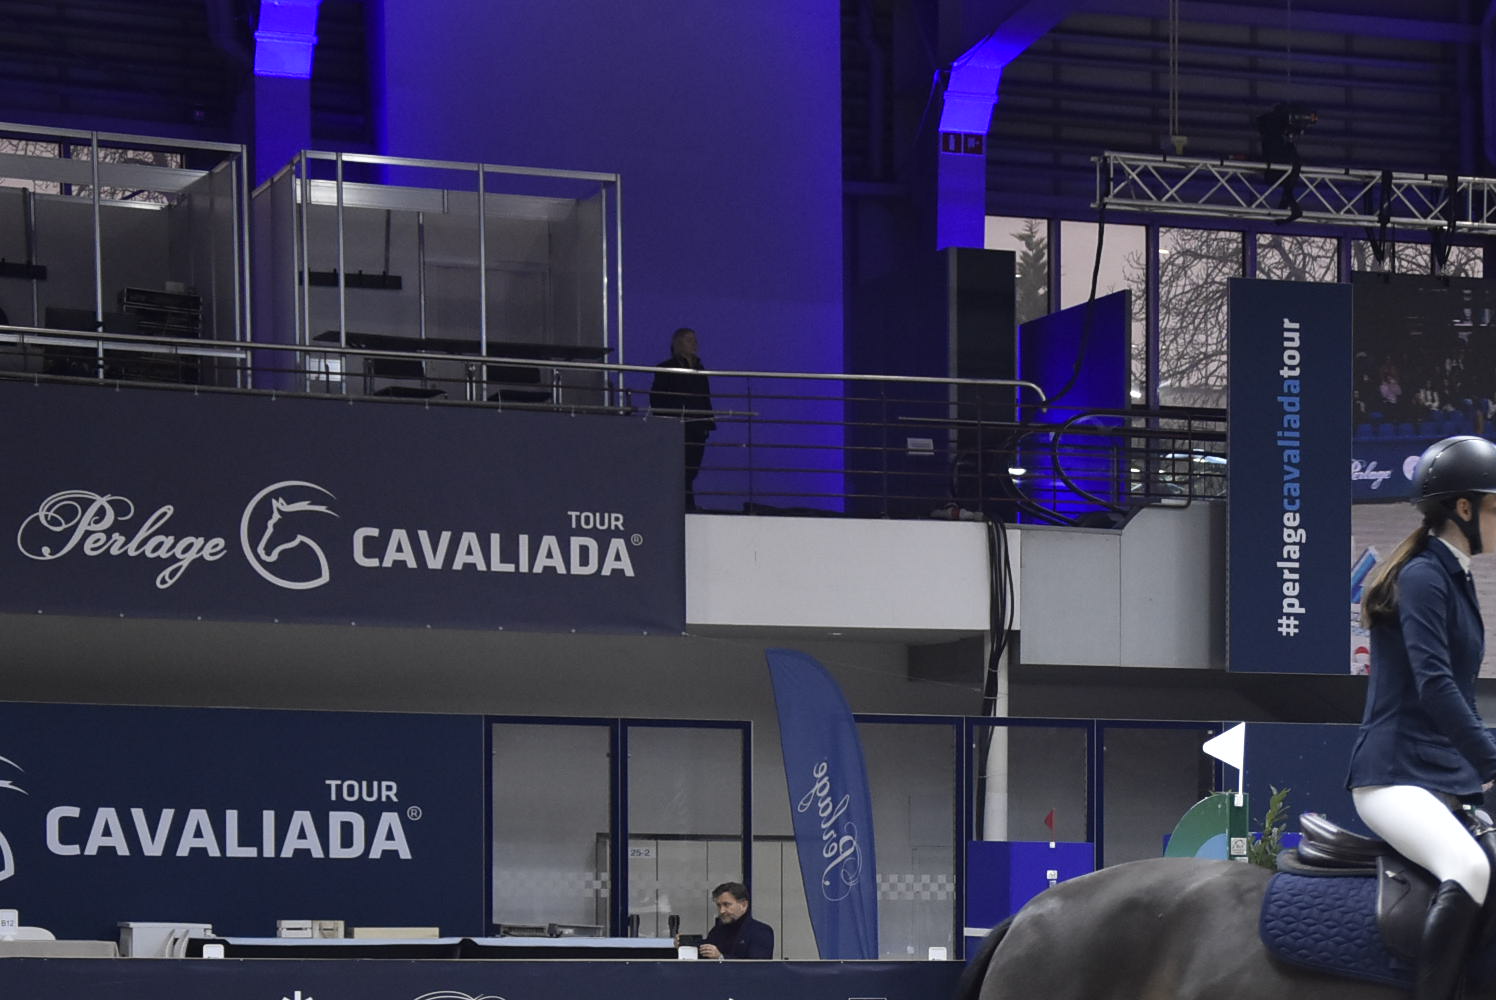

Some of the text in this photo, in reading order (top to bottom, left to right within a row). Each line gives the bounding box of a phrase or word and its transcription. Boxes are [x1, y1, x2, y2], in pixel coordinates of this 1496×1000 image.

[1277, 318, 1306, 637] #perlagecavaliadatour
[17, 489, 227, 589] Perlage
[567, 511, 624, 531] TOUR
[325, 780, 398, 802] TOUR
